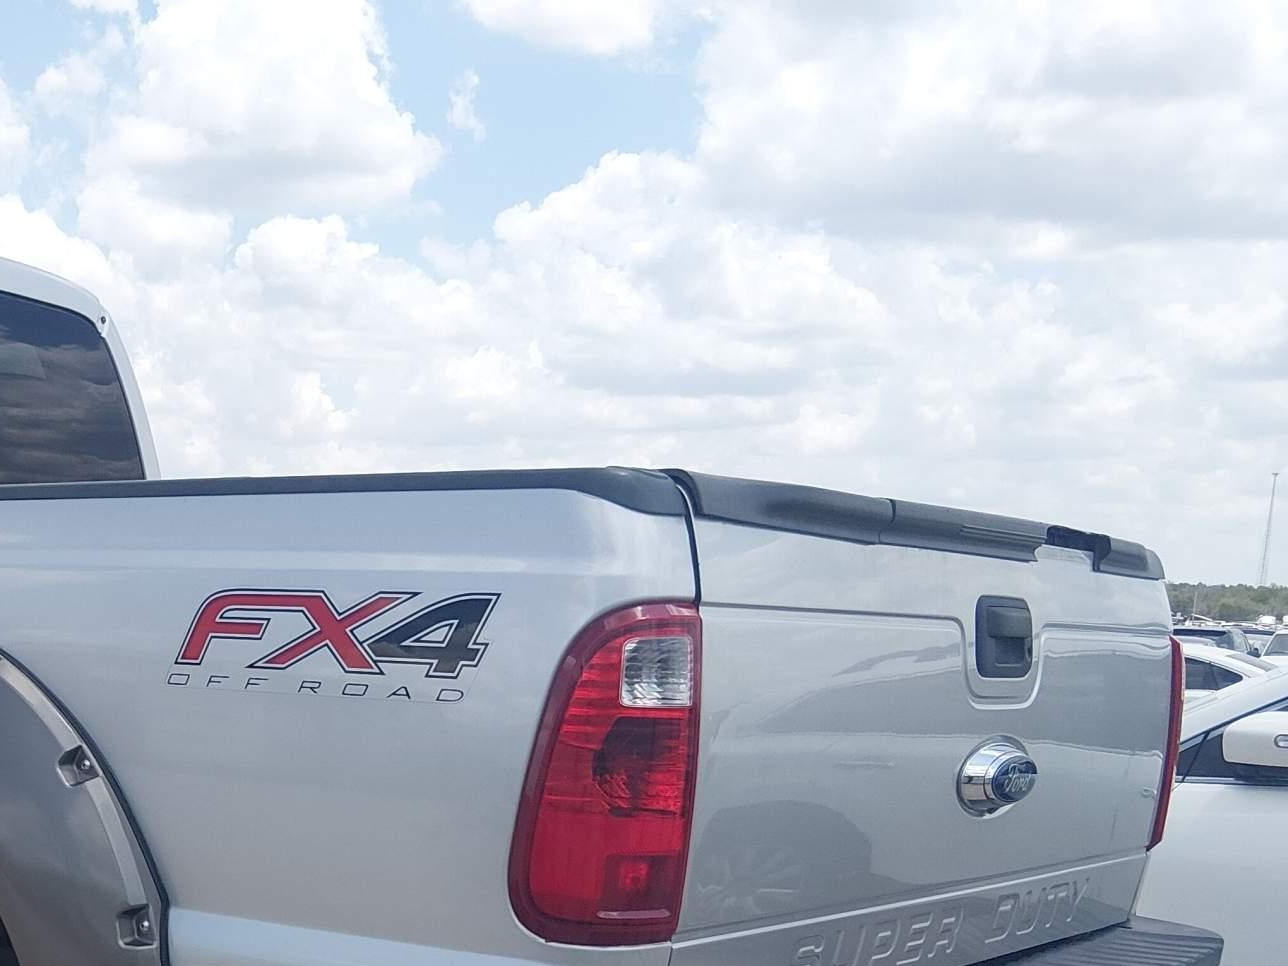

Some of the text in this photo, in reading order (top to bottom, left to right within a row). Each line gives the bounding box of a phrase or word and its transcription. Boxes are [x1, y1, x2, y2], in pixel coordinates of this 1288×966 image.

[174, 588, 502, 678] FX4
[167, 672, 464, 702] OFF ROAD
[1004, 763, 1031, 793] Ford
[985, 877, 1090, 944] DUTY
